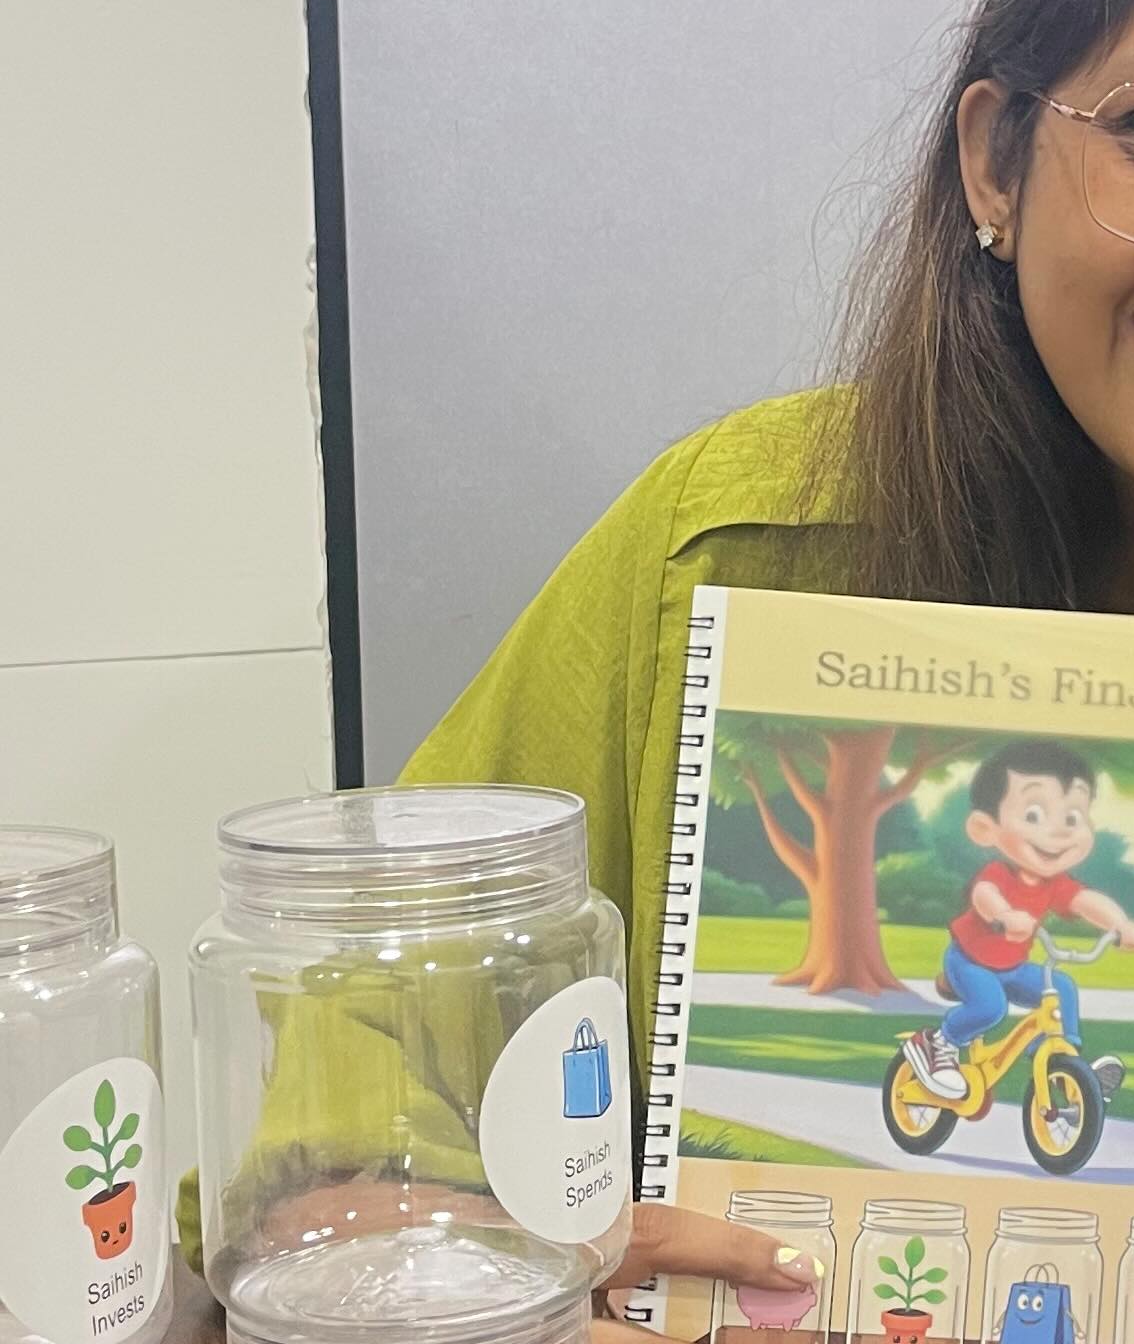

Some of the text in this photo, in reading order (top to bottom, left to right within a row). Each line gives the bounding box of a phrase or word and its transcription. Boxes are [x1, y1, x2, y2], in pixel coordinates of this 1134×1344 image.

[565, 1140, 611, 1178] Saihish
[566, 1169, 613, 1208] Spends
[88, 1261, 143, 1305] Saihish
[92, 1295, 145, 1337] Invests
